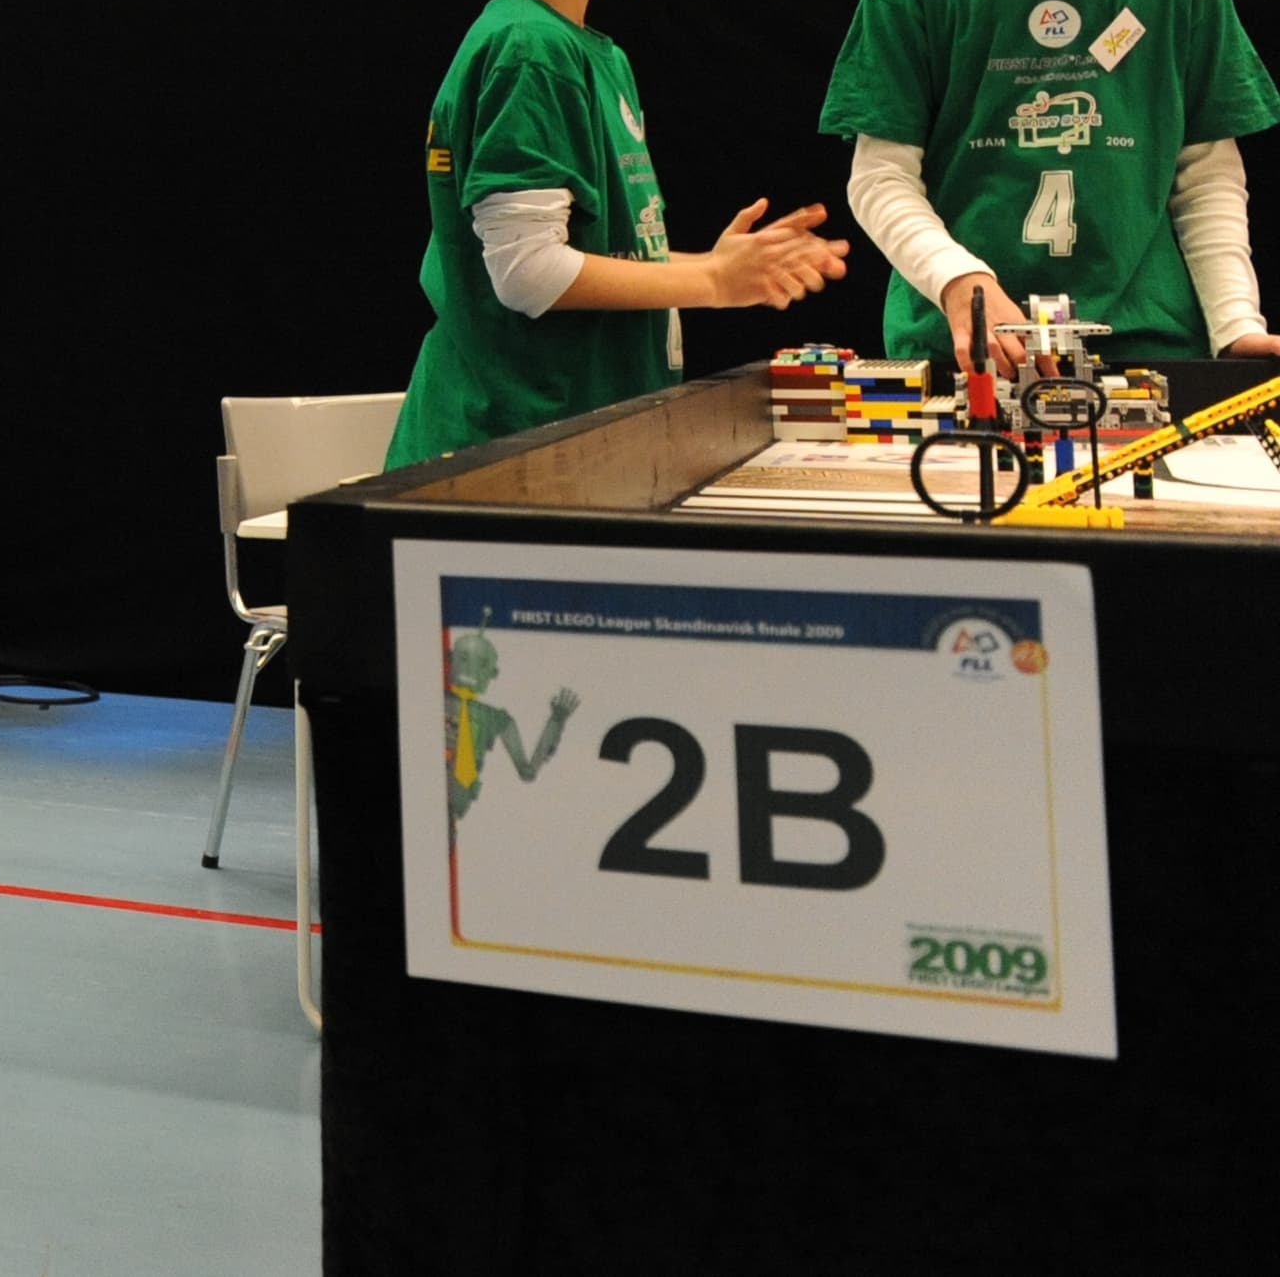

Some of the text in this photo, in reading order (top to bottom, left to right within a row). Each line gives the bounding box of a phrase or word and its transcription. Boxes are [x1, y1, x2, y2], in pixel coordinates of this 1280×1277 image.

[1044, 26, 1066, 36] FLL
[969, 136, 1135, 150] TEAM 2009
[1022, 169, 1077, 257] 4
[511, 610, 552, 625] FIRST
[554, 612, 595, 627] LEGO
[597, 615, 652, 633] League
[960, 657, 993, 671] FLL
[598, 717, 886, 892] 2B
[910, 936, 1048, 985] 2009
